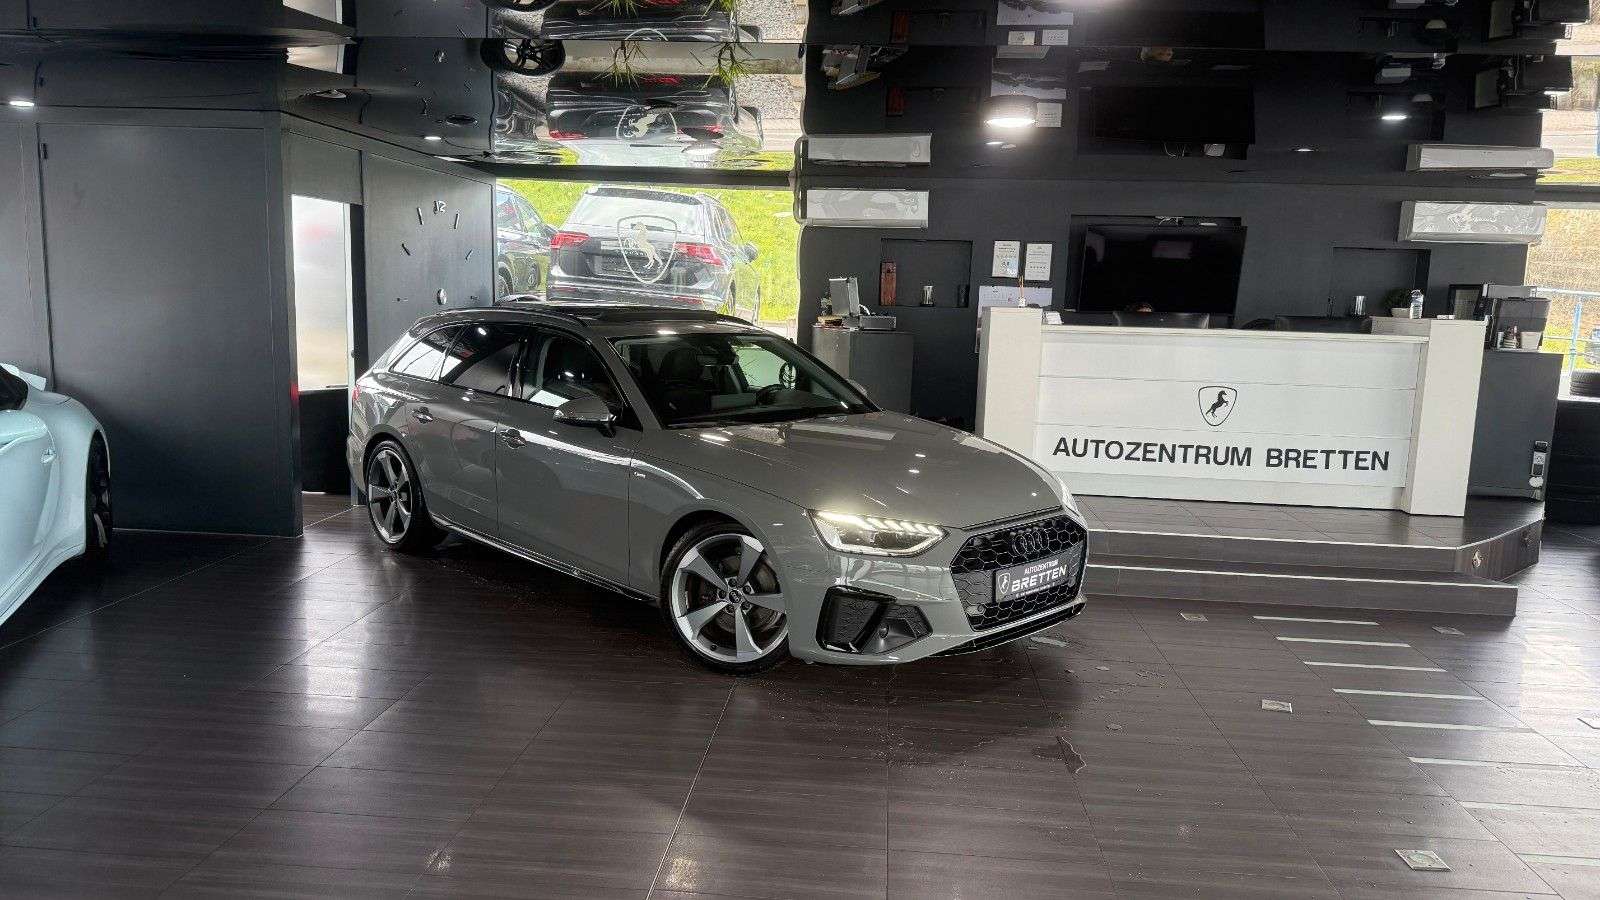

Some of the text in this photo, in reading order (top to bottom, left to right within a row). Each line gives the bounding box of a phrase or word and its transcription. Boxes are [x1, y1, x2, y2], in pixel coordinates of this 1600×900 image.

[1052, 437, 1390, 471] AUTOZENTRUM BRETTEN
[1012, 564, 1067, 592] BRETTEN
